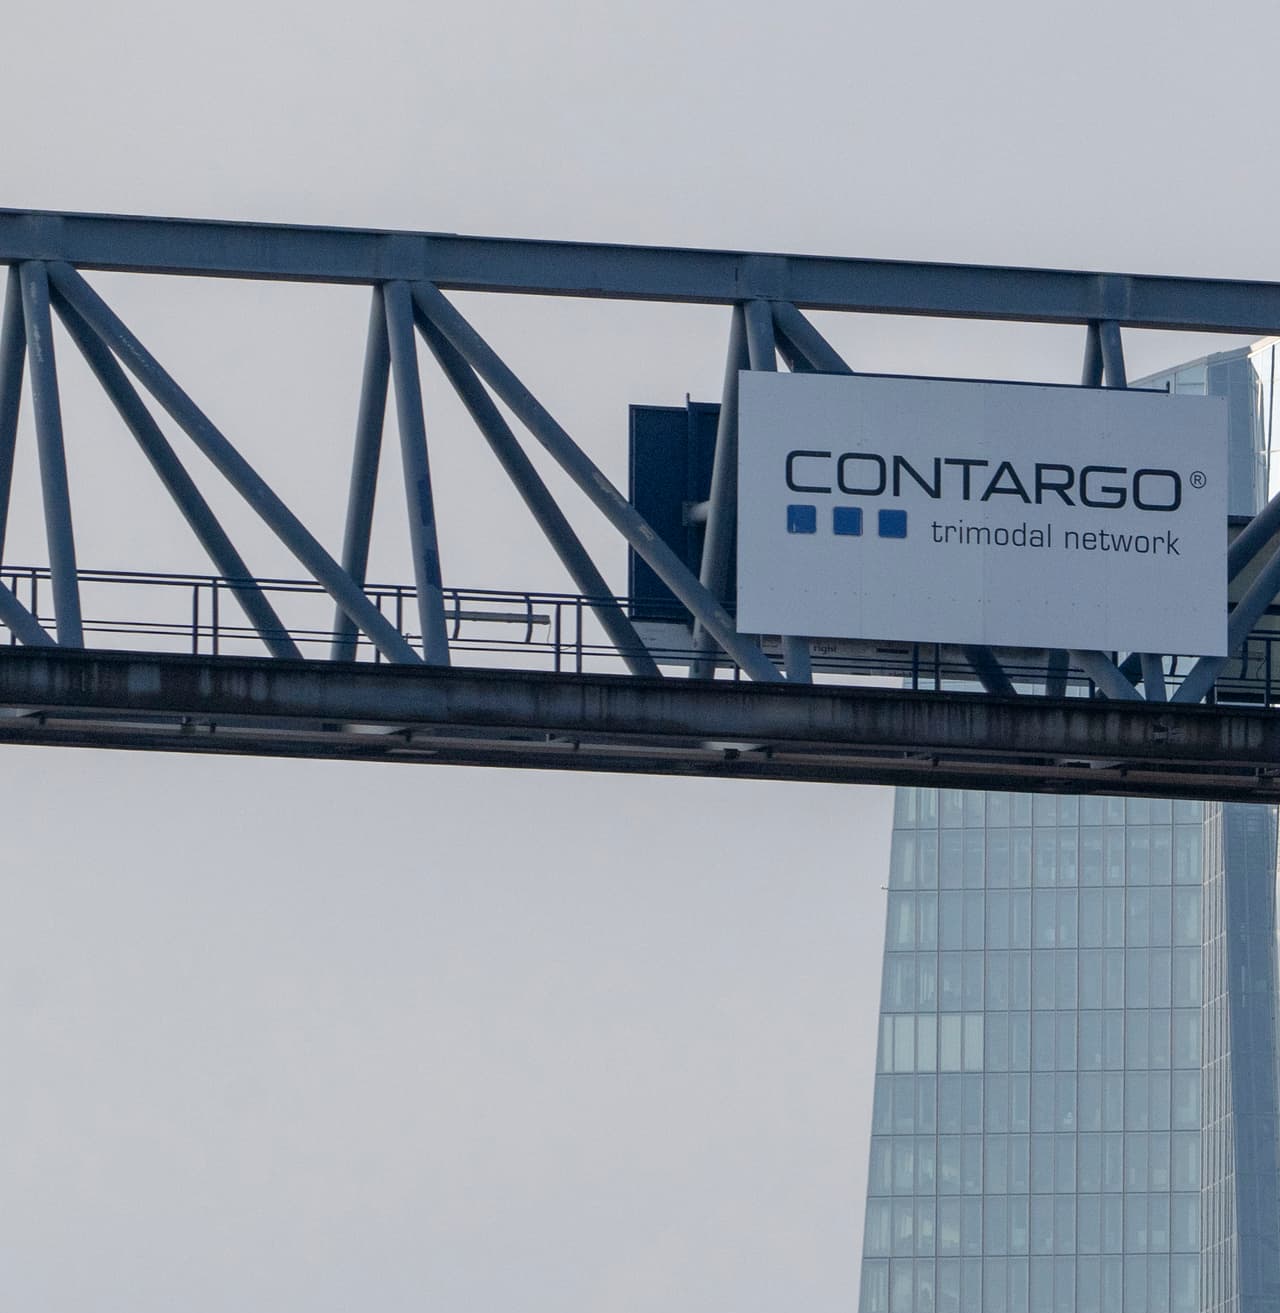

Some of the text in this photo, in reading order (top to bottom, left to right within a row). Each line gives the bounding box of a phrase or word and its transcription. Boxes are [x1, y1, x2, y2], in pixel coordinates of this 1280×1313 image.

[785, 449, 1183, 512] CONTARGO
[931, 519, 1181, 556] trimodal network
